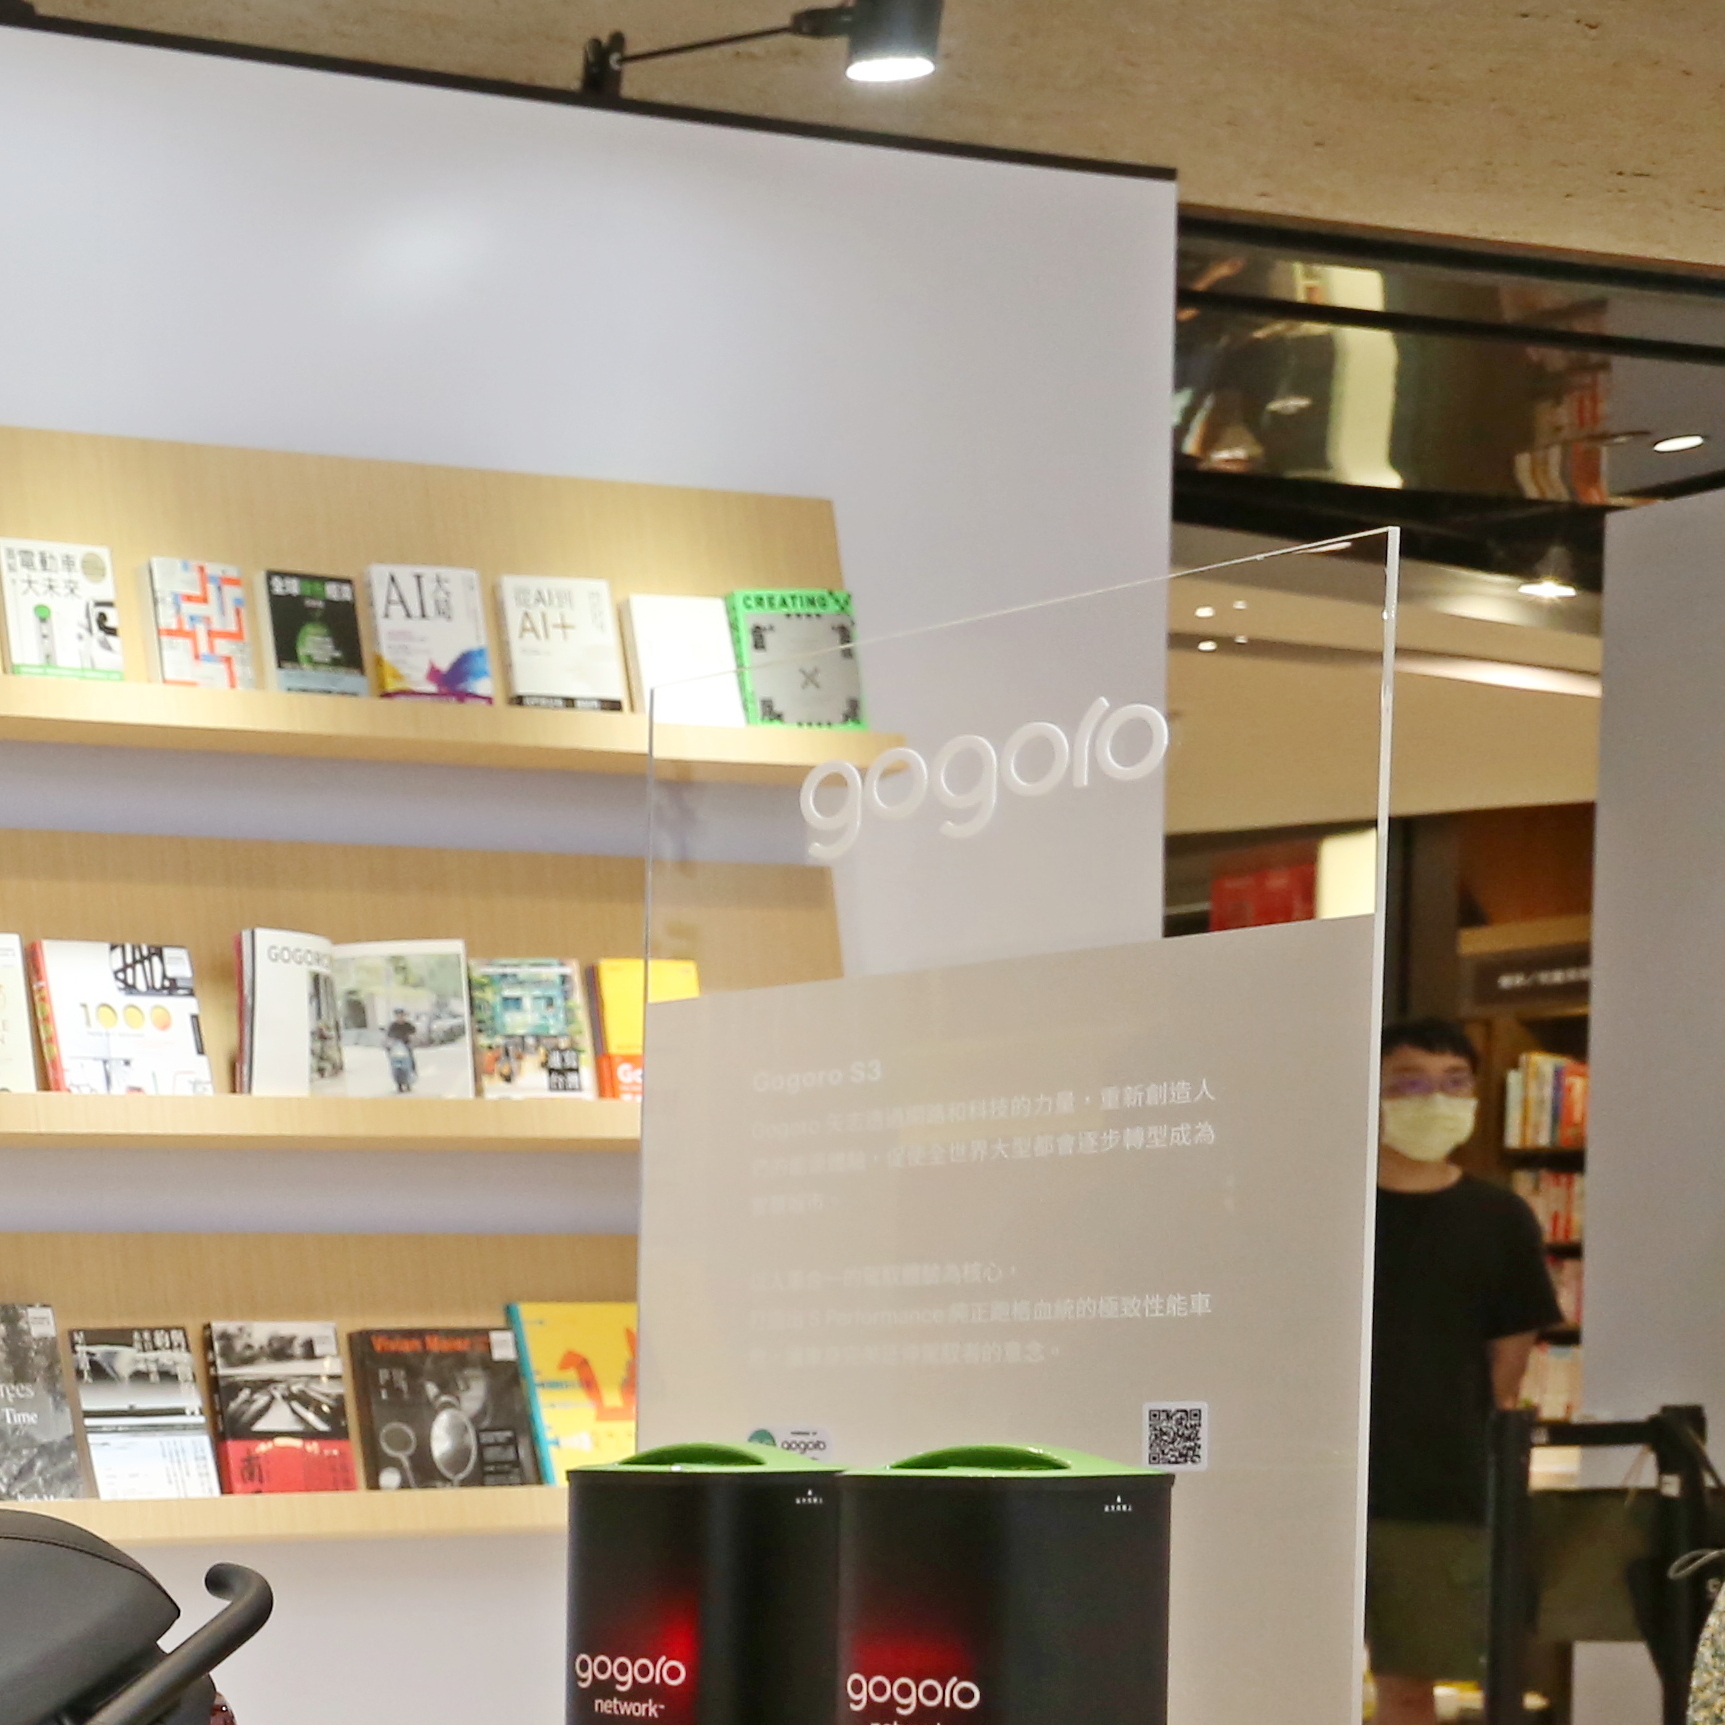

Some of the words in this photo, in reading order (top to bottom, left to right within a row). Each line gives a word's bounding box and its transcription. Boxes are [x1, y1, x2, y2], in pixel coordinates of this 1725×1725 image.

[742, 595, 829, 611] CREATING
[799, 697, 1169, 859] gogoro
[752, 1069, 843, 1095] Gogoro
[849, 1059, 883, 1084] S3
[2, 1407, 39, 1424] Time
[575, 1653, 687, 1692] gogoro
[846, 1672, 981, 1715] gogoro
